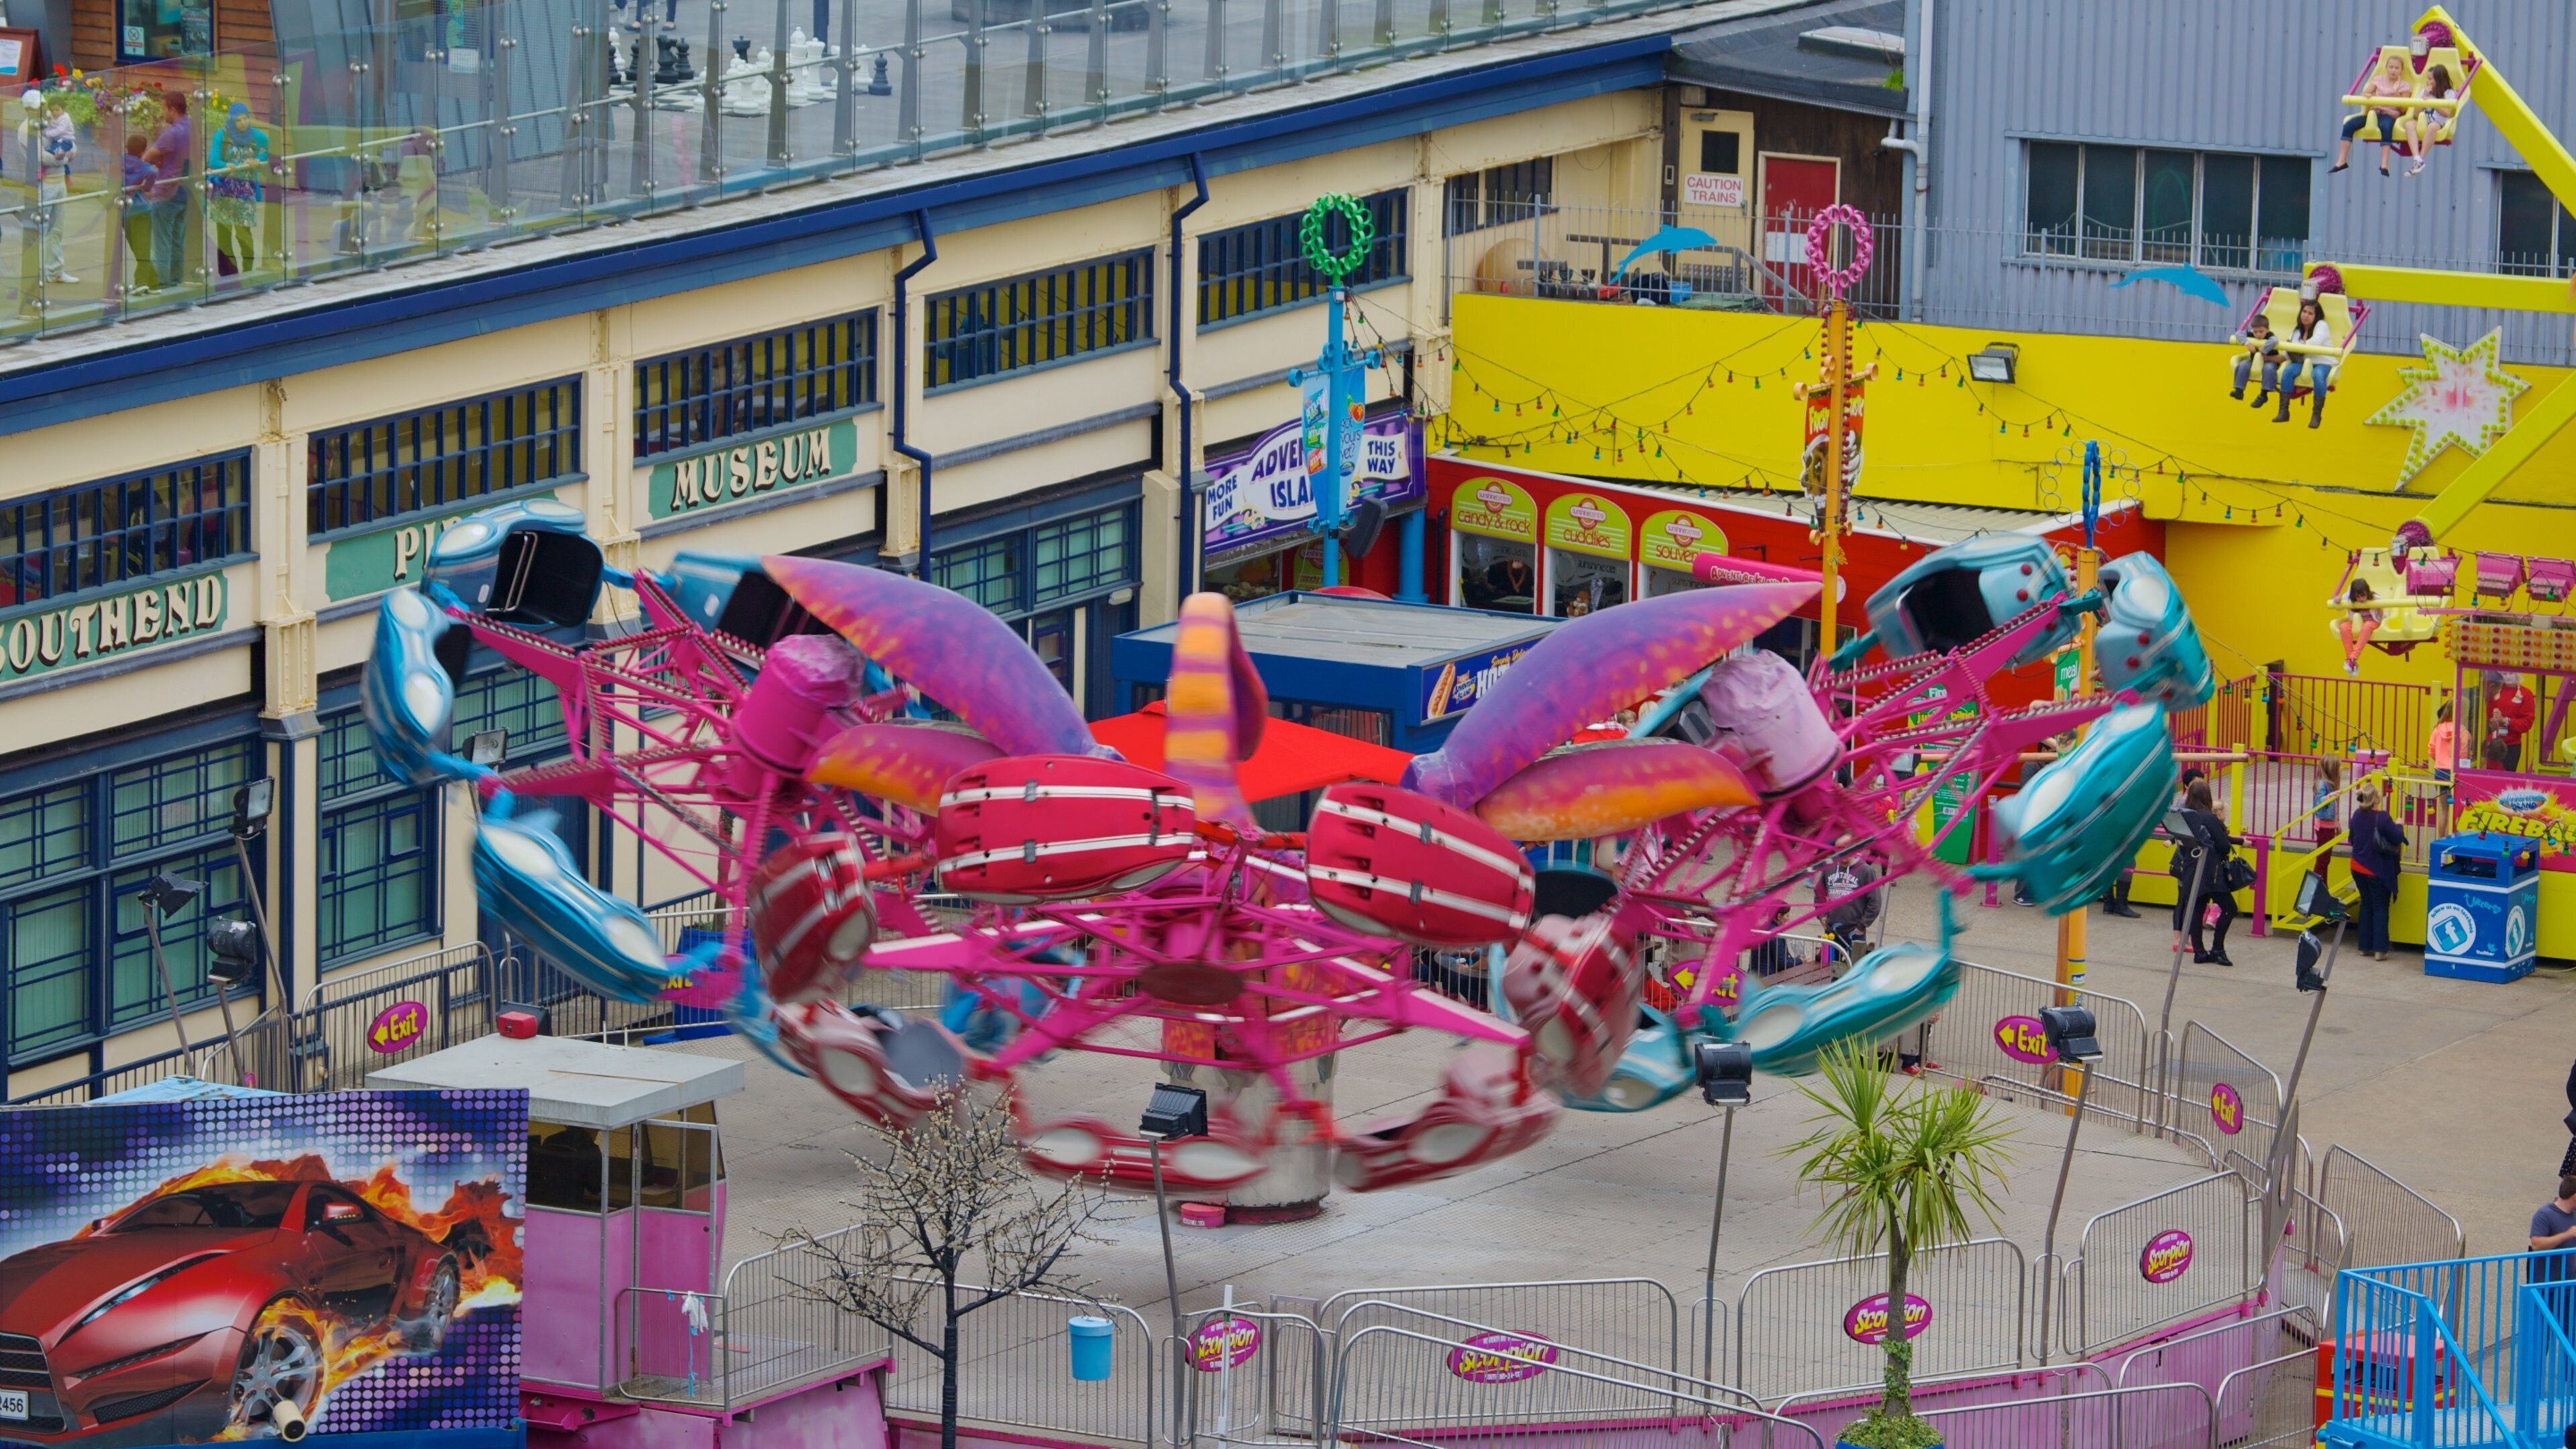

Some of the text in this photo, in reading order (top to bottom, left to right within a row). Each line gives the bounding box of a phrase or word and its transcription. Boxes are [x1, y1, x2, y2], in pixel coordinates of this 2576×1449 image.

[1686, 176, 1741, 191] CAUTION
[1691, 189, 1737, 203] TRAINS
[1368, 440, 1395, 457] THIS
[671, 427, 831, 512] MUSEUM
[1367, 458, 1396, 474] WAY
[1207, 474, 1238, 504] MORE
[1212, 498, 1233, 521] FUN
[1458, 511, 1531, 535] candy & rock
[1563, 528, 1610, 549] cuddlies
[1656, 544, 1702, 563] souven
[1710, 566, 1754, 584] ADVENTURE
[0, 575, 222, 674] OUTHEND
[2060, 659, 2078, 680] meal
[390, 1008, 418, 1041] Exit
[2017, 1024, 2048, 1057] Exit
[2220, 1092, 2235, 1127] Exit
[2148, 1240, 2190, 1275] Scorpion
[1854, 1303, 1927, 1334] Scorion
